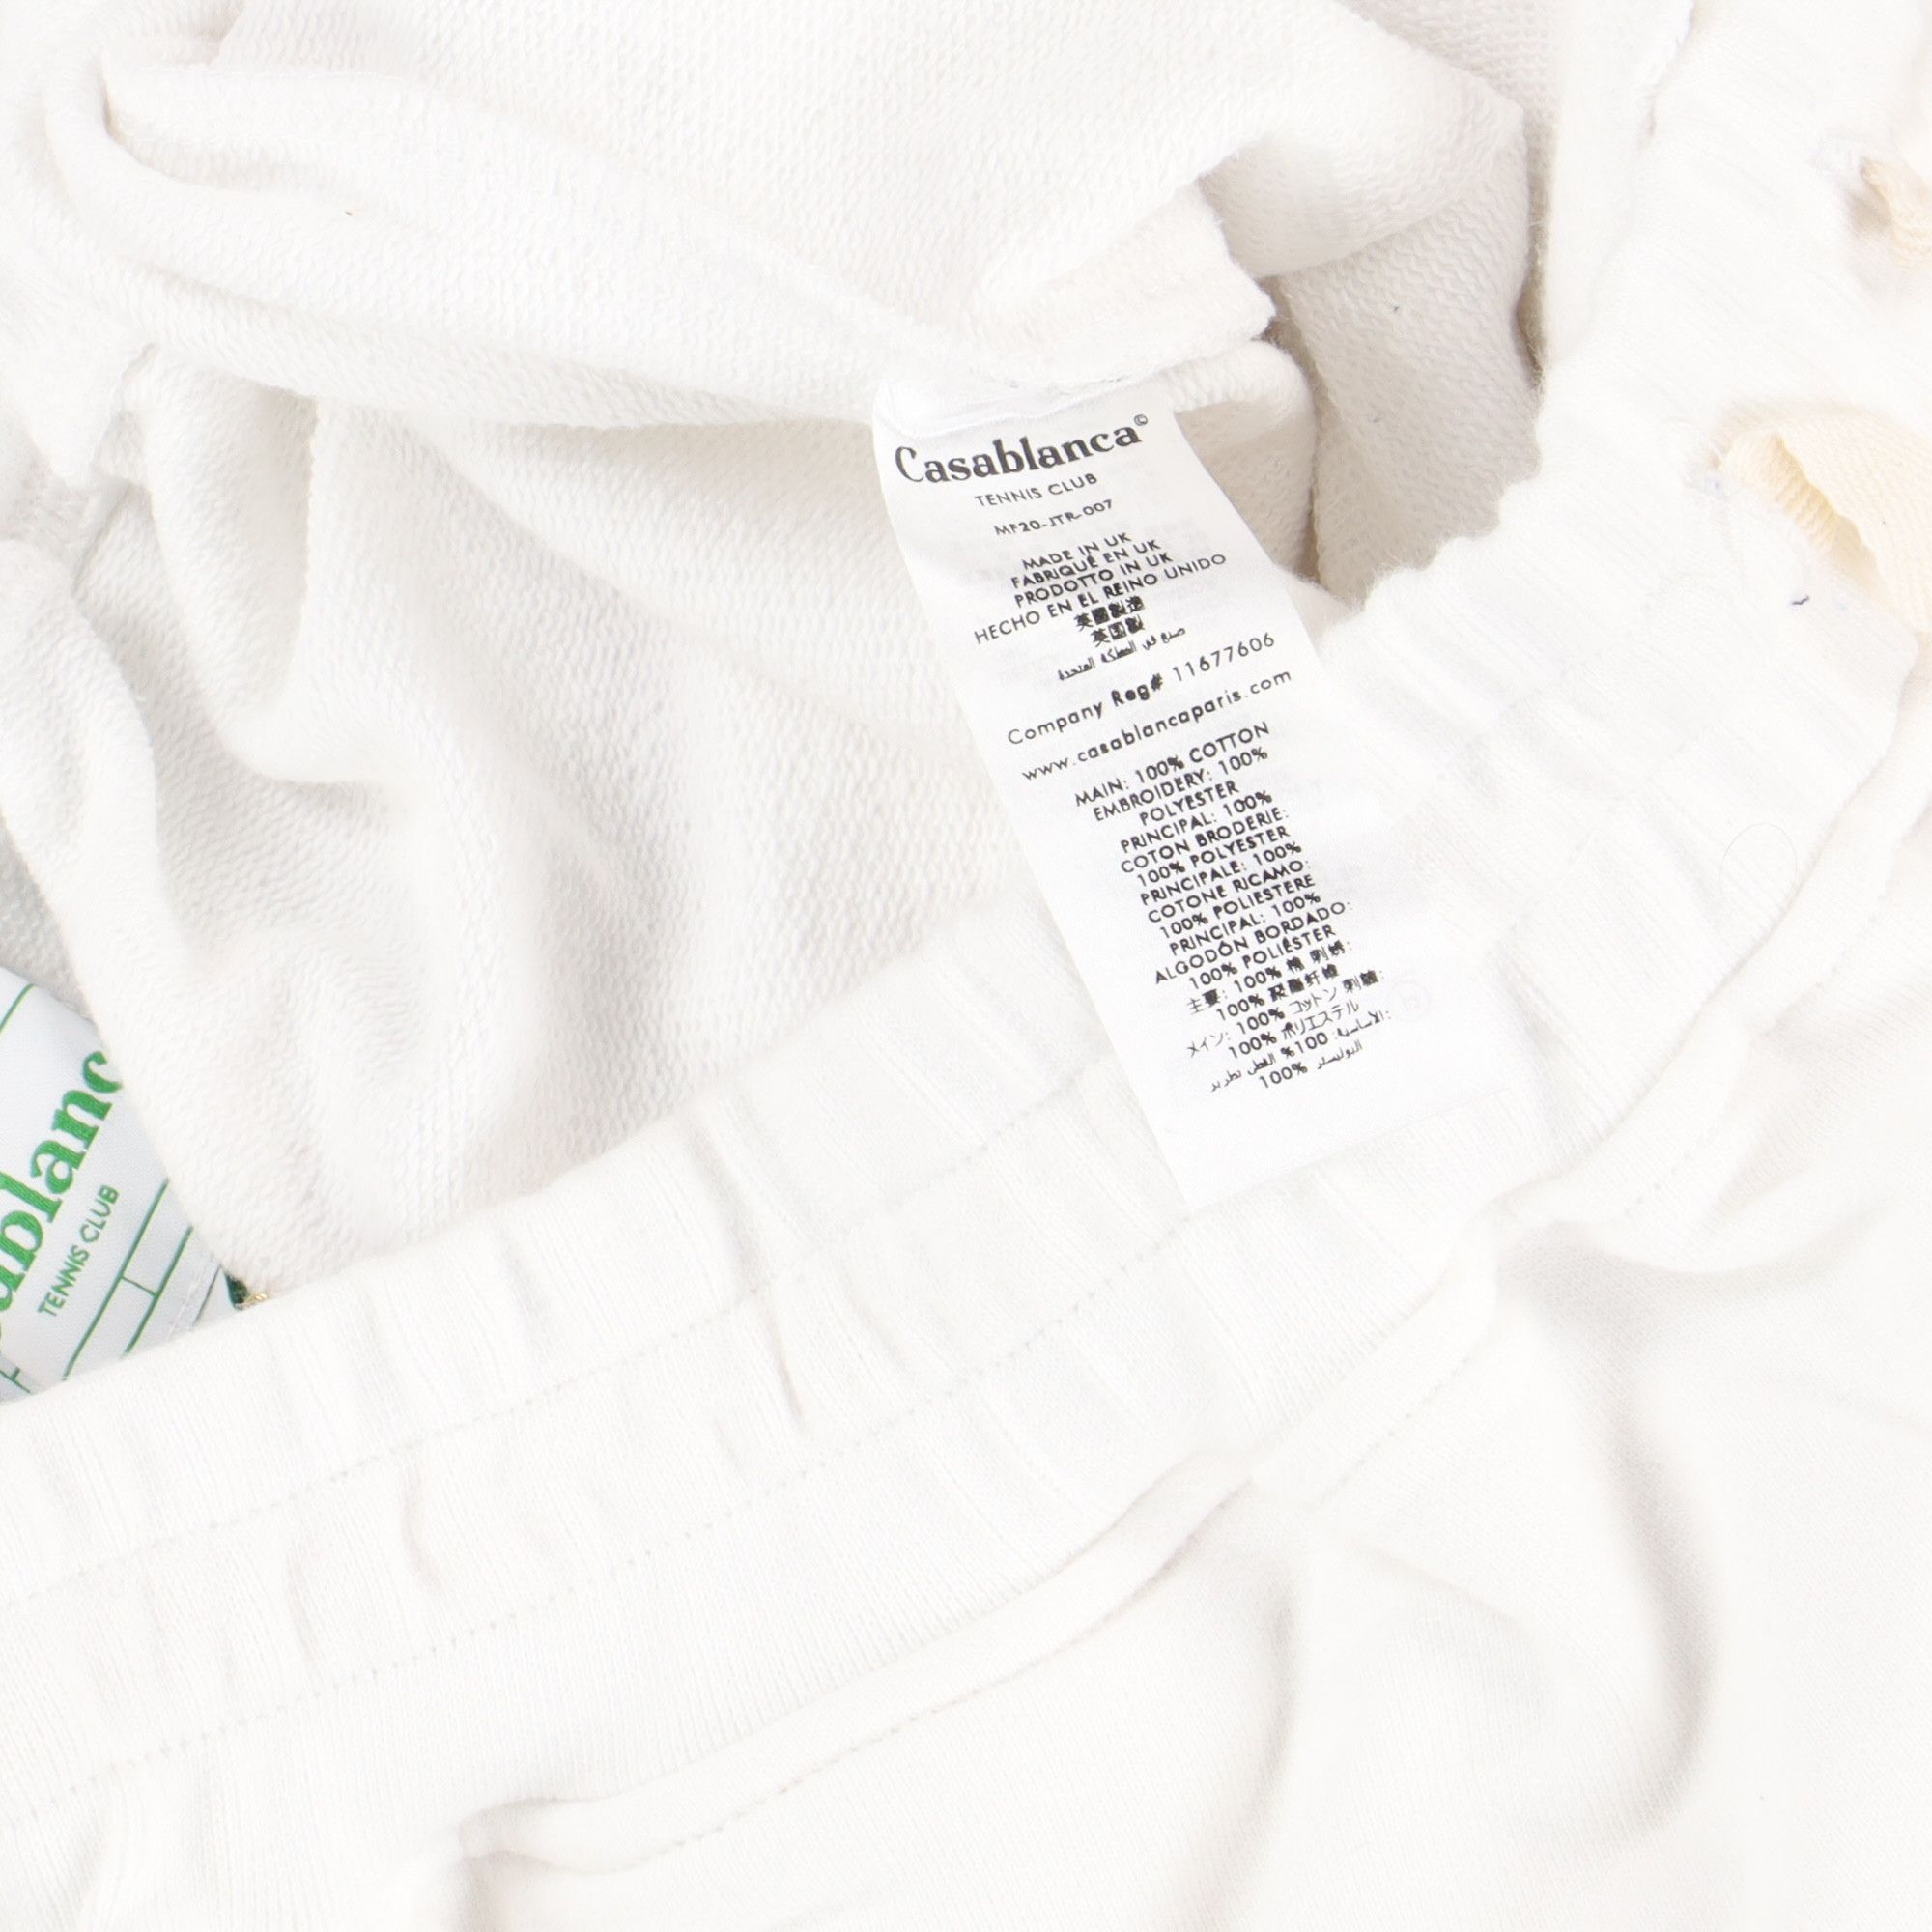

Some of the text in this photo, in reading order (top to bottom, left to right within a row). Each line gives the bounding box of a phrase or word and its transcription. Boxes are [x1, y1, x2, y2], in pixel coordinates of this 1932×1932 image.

[975, 473, 1097, 508] TENNIS CLUB
[994, 499, 1113, 536] MF20-JTR-007
[1014, 553, 1173, 608] PRODOTTO IN UK
[1023, 532, 1130, 570] MADE IN UK
[1106, 549, 1130, 565] EN
[1134, 539, 1161, 554] UK
[973, 553, 1226, 644] HECHO EN EL REINO UNIDO
[1008, 700, 1104, 745] Company
[1172, 632, 1275, 682] 11677606
[1022, 669, 1292, 781] www.casablancaparis.com
[1074, 722, 1269, 806] MAIN: 100% COTTON
[1093, 747, 1267, 821] EMBROIDERY: 100%
[1120, 789, 1272, 853] PRINCIPAL: 100%
[1140, 780, 1239, 826] POLYESTER
[1121, 808, 1289, 873] COTON BRODERIE:
[1137, 826, 1290, 886] 100% POLYESTER
[1141, 842, 1302, 905] PRINCIPALE: 100%
[1148, 859, 1312, 923] COTONE RICAMO:
[1160, 874, 1316, 938] 100% POLIESTERE
[1170, 892, 1321, 955] PRINCIPAL: 100%
[1154, 900, 1352, 984] ALGODÓN BORDADO:
[1189, 924, 1336, 989] 100% POLIÉSTER
[1216, 994, 1265, 1020] 100%
[1234, 967, 1282, 993] 100%
[1229, 1032, 1277, 1059] 100%
[1236, 1009, 1286, 1035] 100%
[1259, 1063, 1308, 1089] 100%
[38, 1183, 120, 1319] TENNIS CLUB
